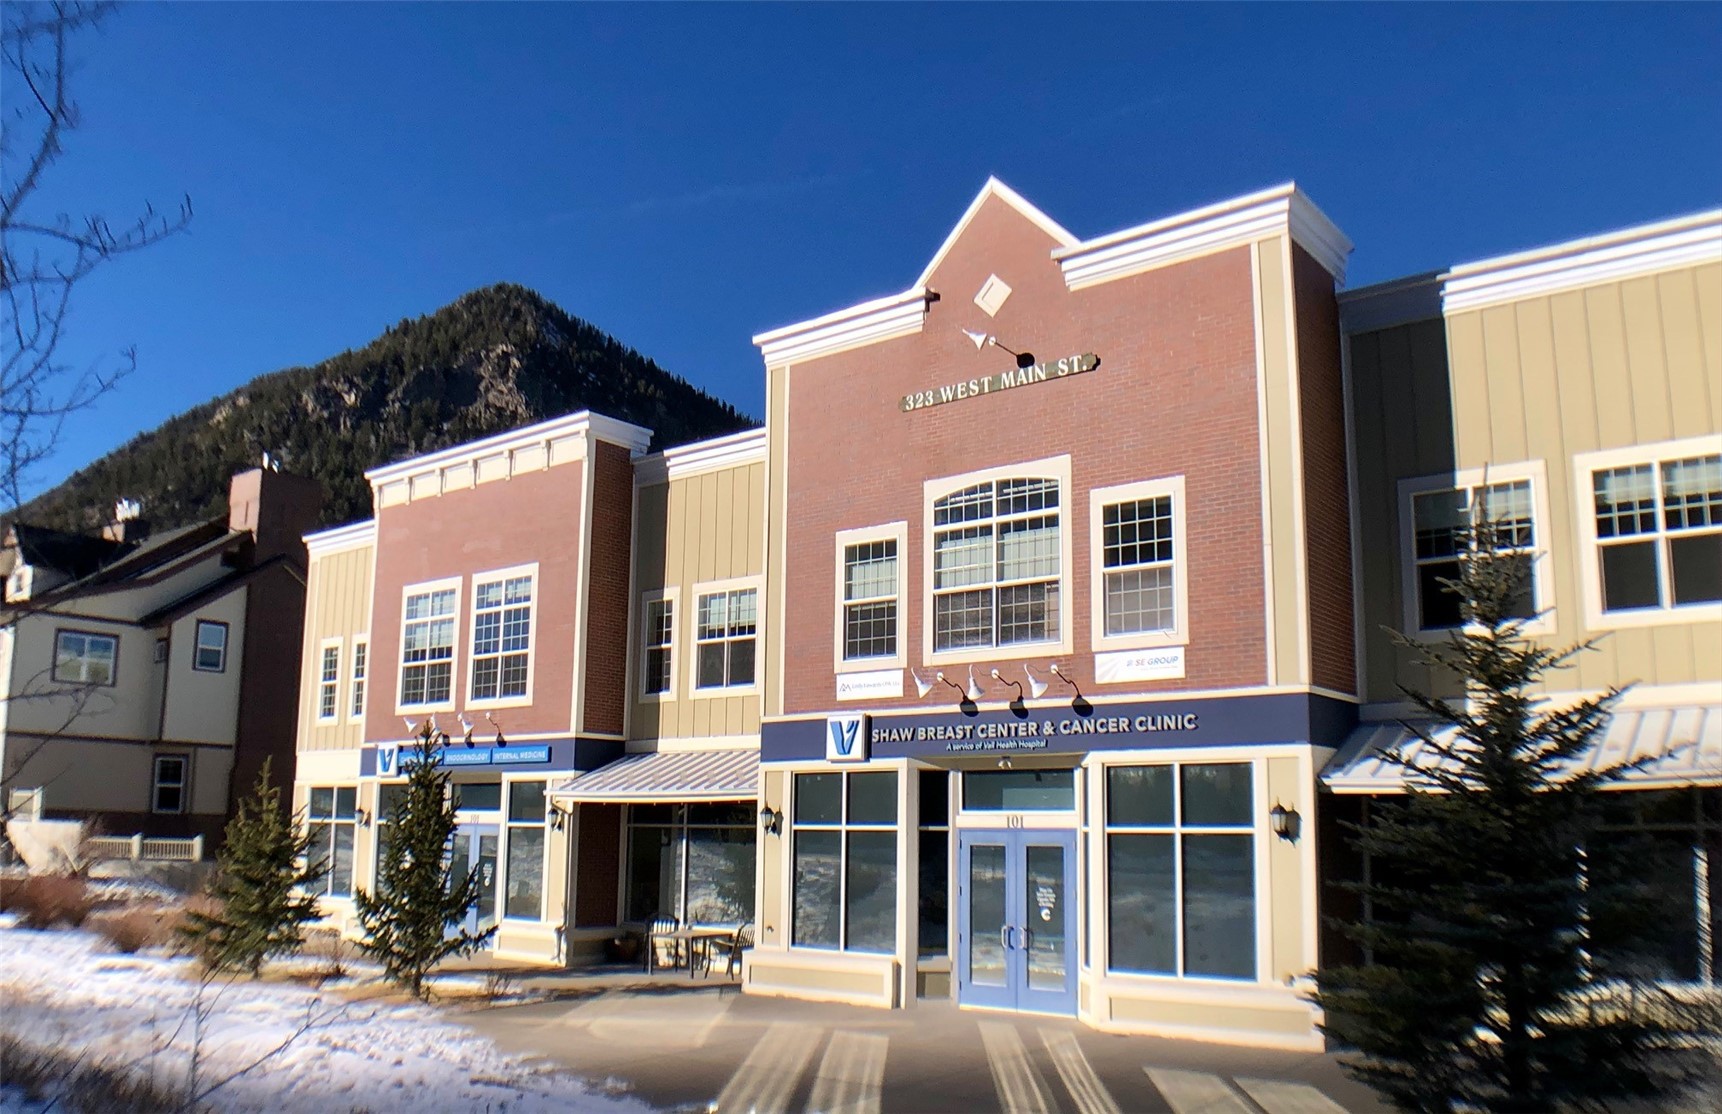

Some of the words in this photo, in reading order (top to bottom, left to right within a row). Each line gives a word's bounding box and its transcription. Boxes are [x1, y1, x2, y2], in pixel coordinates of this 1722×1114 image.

[905, 391, 934, 411] 323
[940, 376, 993, 403] WEST
[1001, 363, 1047, 390] MAIN
[1057, 354, 1088, 376] ST.
[1147, 656, 1179, 666] GROUP
[872, 727, 915, 743] SHAW
[917, 725, 973, 741] BREAST
[977, 722, 1038, 739] CENTER
[1043, 721, 1055, 736] &
[1060, 717, 1130, 735] CANCER
[1135, 713, 1197, 732] CLINIC
[996, 740, 1018, 749] Health
[1018, 739, 1046, 750] Hospital
[1006, 815, 1024, 829] 101
